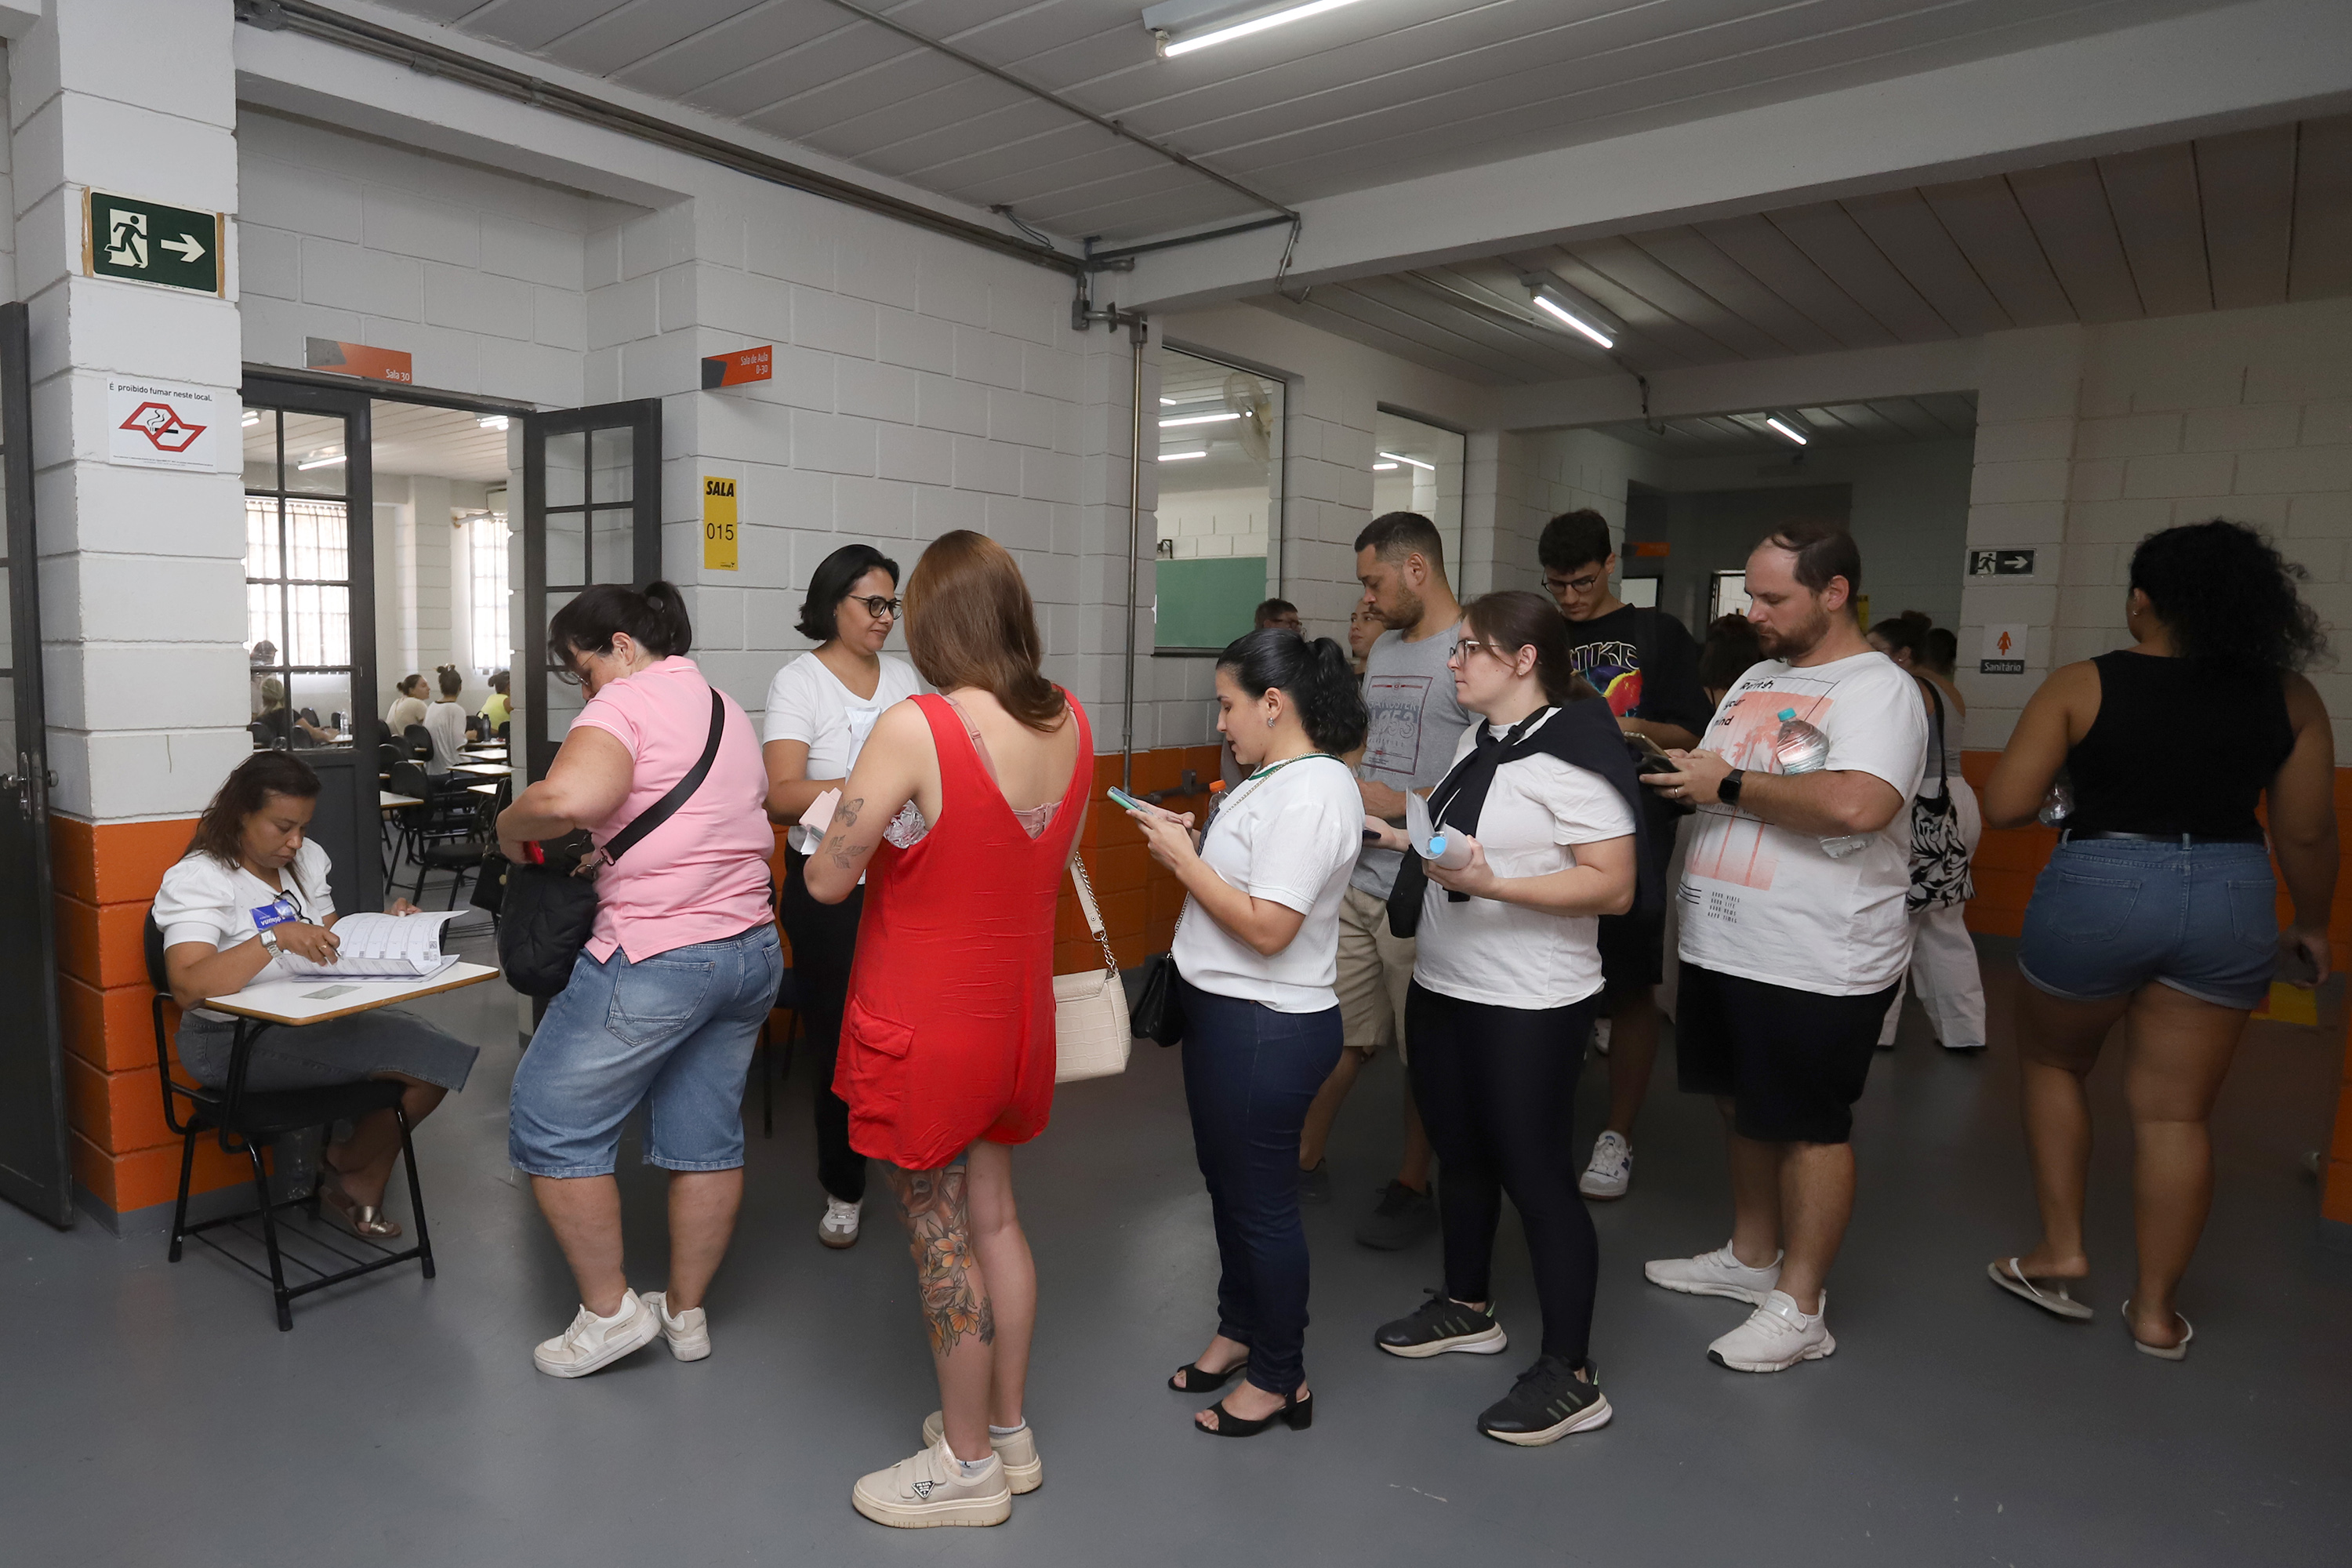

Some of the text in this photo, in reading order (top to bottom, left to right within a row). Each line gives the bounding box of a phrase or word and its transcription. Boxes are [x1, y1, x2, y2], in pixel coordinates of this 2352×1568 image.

[740, 351, 768, 365] Sala de Aula
[386, 368, 410, 381] Sala 30
[109, 382, 114, 390] É
[118, 384, 149, 394] proibido
[150, 387, 172, 397] fumar
[194, 393, 212, 401] local.
[706, 480, 735, 497] SALA
[706, 522, 734, 541] 015
[1569, 641, 1640, 673] IKE
[1984, 662, 2022, 672] Sanitário
